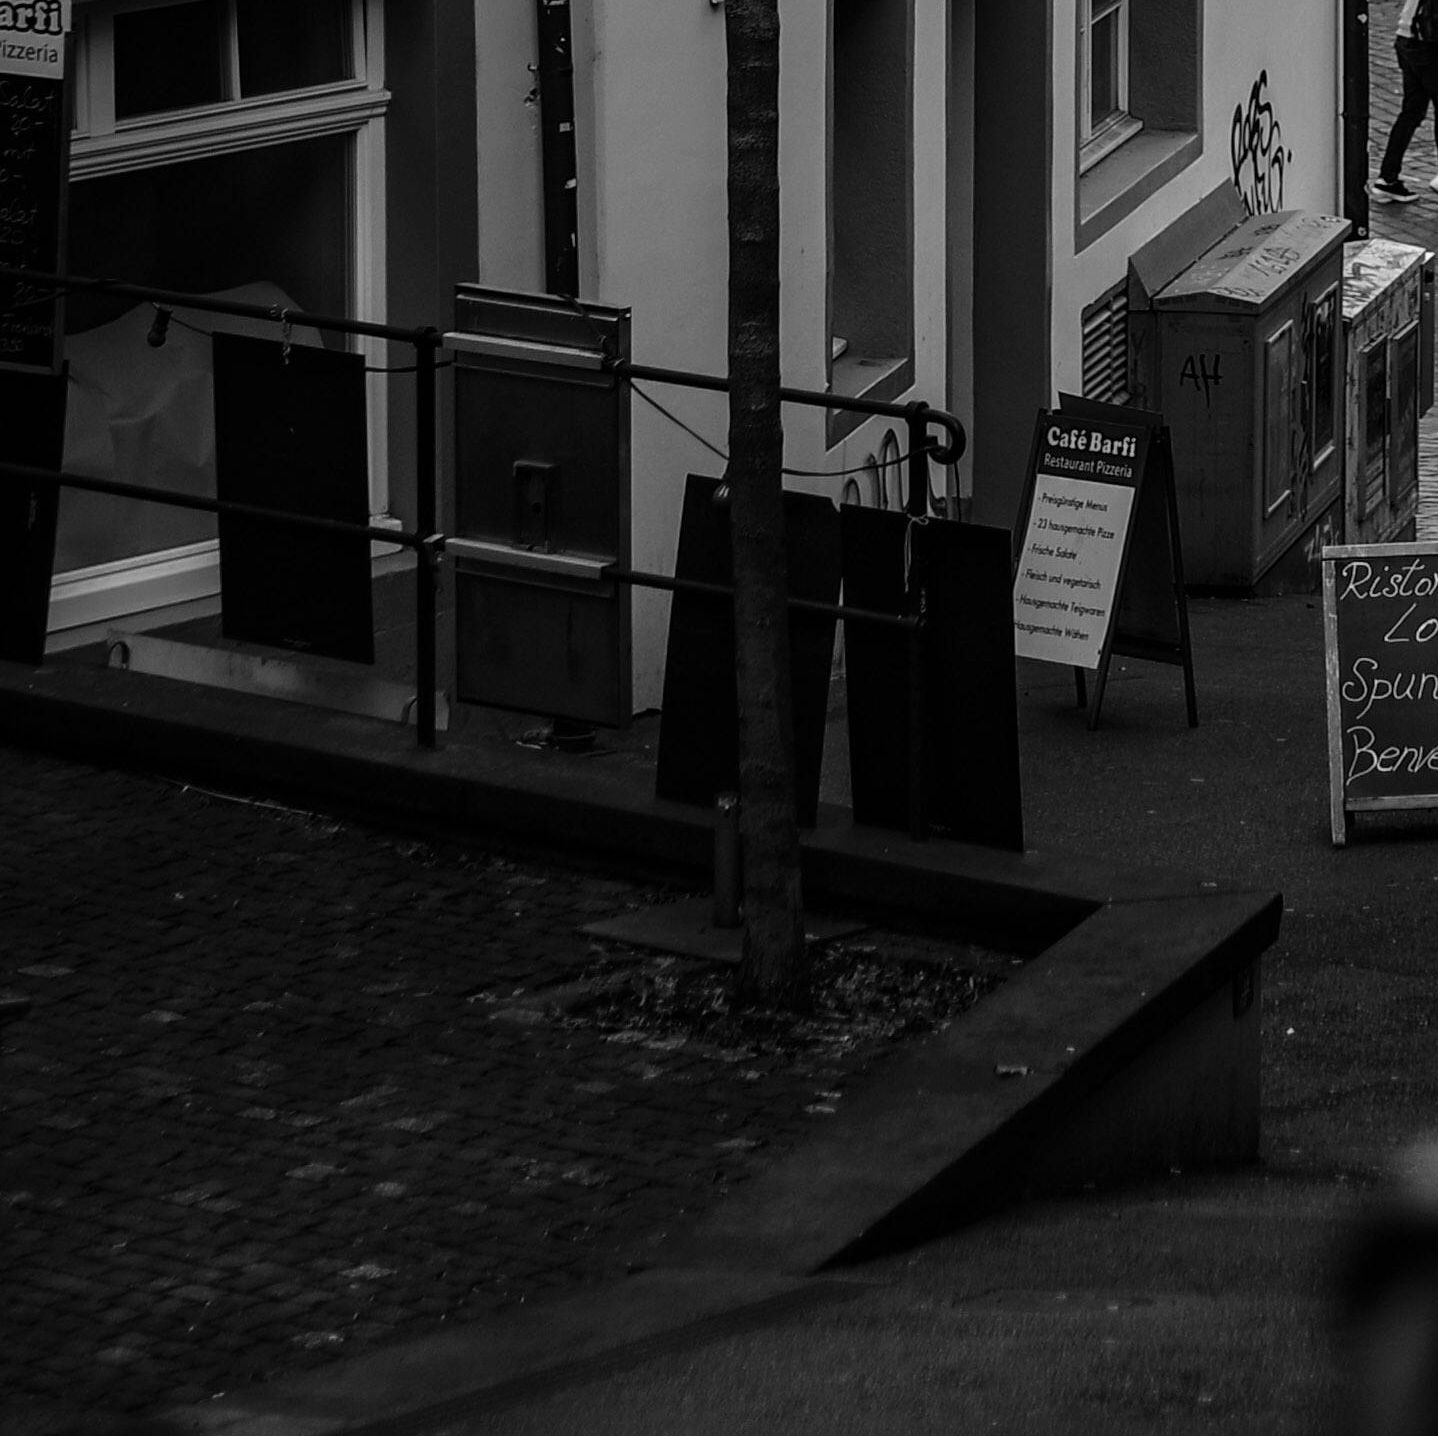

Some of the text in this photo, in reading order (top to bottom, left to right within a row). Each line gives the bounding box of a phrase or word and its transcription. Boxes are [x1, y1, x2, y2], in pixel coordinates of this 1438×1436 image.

[0, 40, 58, 63] izzeria
[1046, 425, 1137, 458] Café Barfi
[1044, 452, 1133, 479] Restaurant Pizzeria
[1048, 520, 1096, 537] hausgemachte
[1032, 543, 1054, 556] Frische
